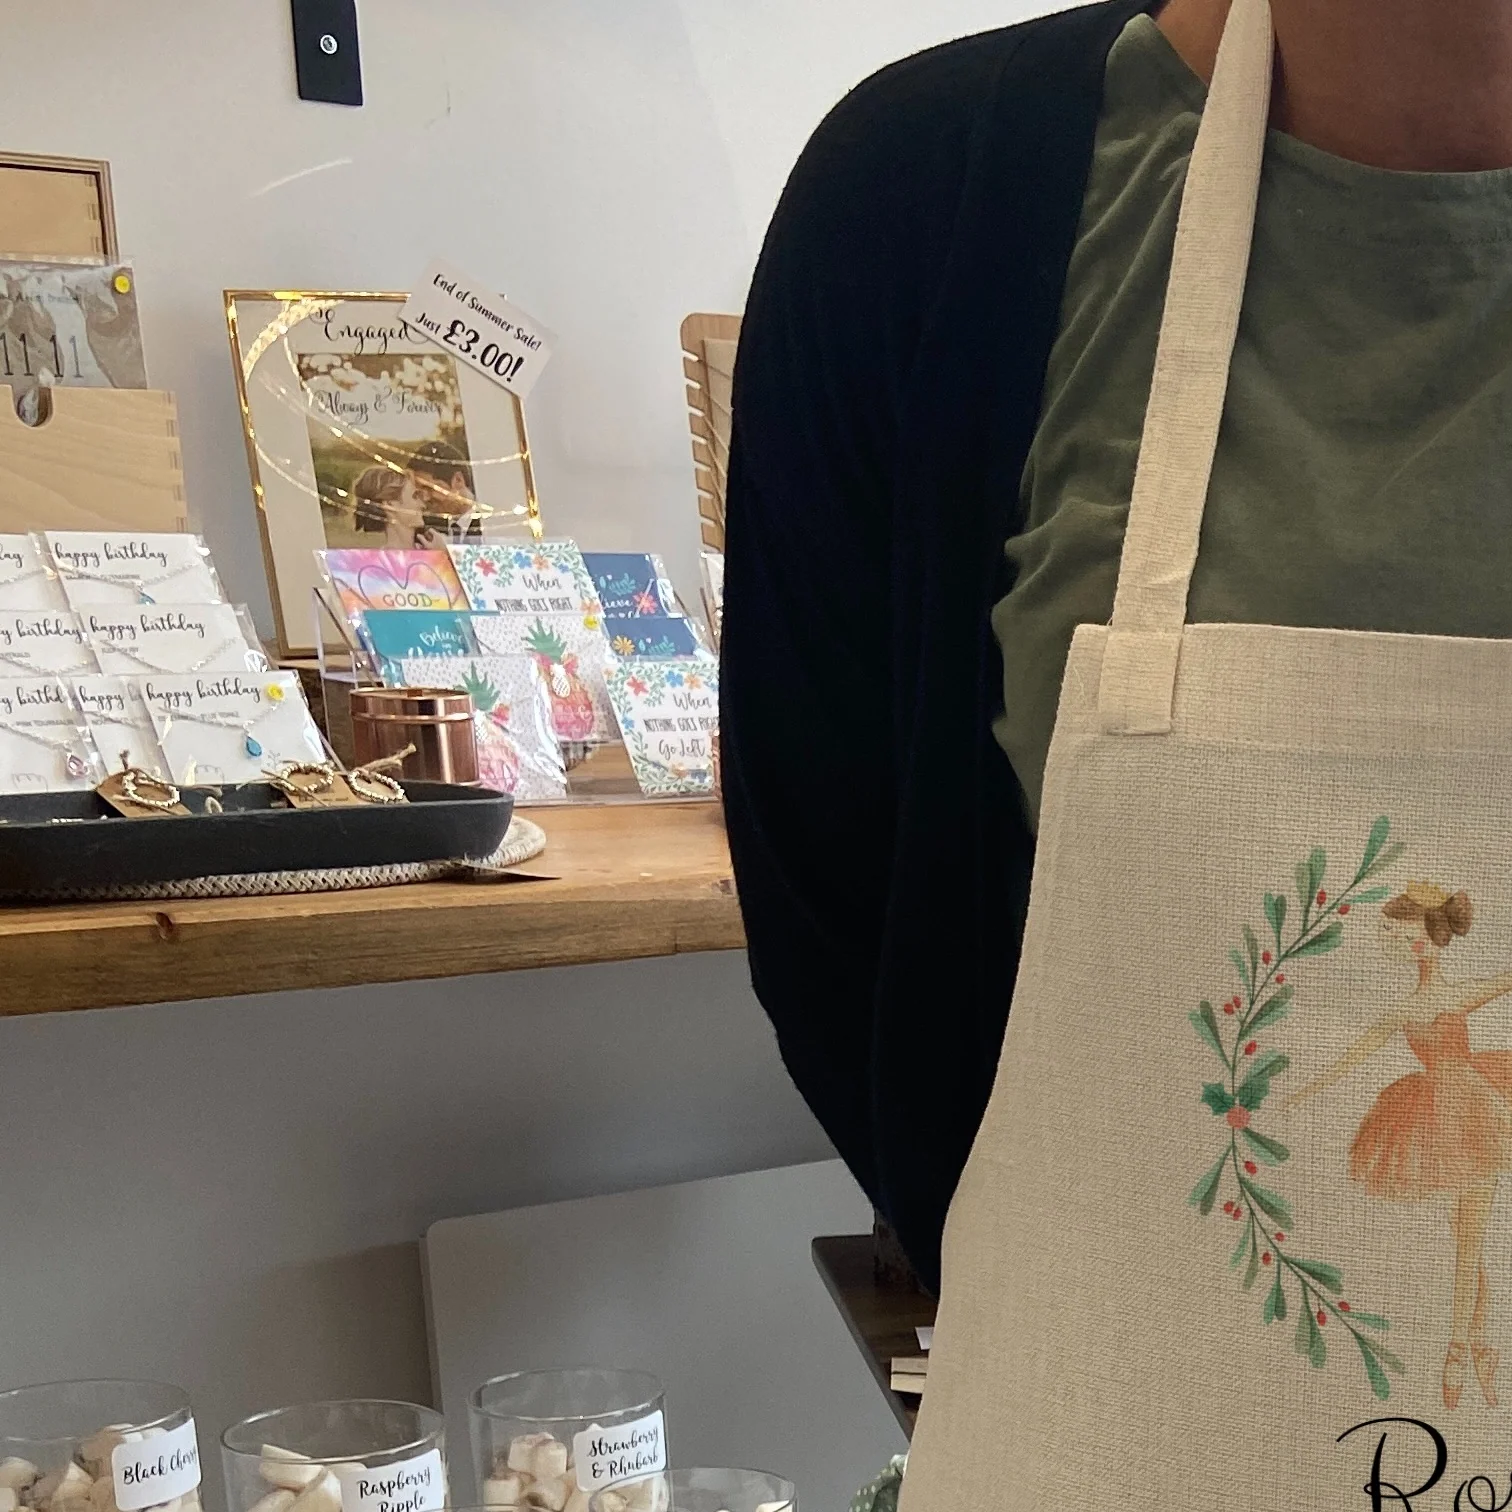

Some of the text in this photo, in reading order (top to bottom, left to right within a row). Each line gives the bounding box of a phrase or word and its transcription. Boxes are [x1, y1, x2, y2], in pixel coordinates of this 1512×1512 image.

[433, 273, 542, 352] End of Summer Sale!
[309, 308, 428, 357] Engaged
[415, 312, 525, 382] Just £3.00!
[372, 385, 392, 413] &
[55, 542, 100, 568] happy
[104, 542, 168, 568] birthday
[522, 573, 562, 592] When
[383, 592, 433, 607] GOOD
[494, 598, 528, 613] NOTHING
[16, 618, 83, 644] birthday
[90, 613, 205, 640] happy birthday
[16, 684, 65, 706] birthd
[79, 685, 125, 710] happy
[146, 682, 192, 708] happy
[195, 677, 261, 704] birthday
[673, 692, 712, 710] When
[658, 738, 706, 761] Go Left
[587, 1426, 659, 1457] Strawberry
[121, 1455, 168, 1486] Black
[591, 1451, 659, 1479] & Rhubarb
[356, 1466, 431, 1500] Raspberry
